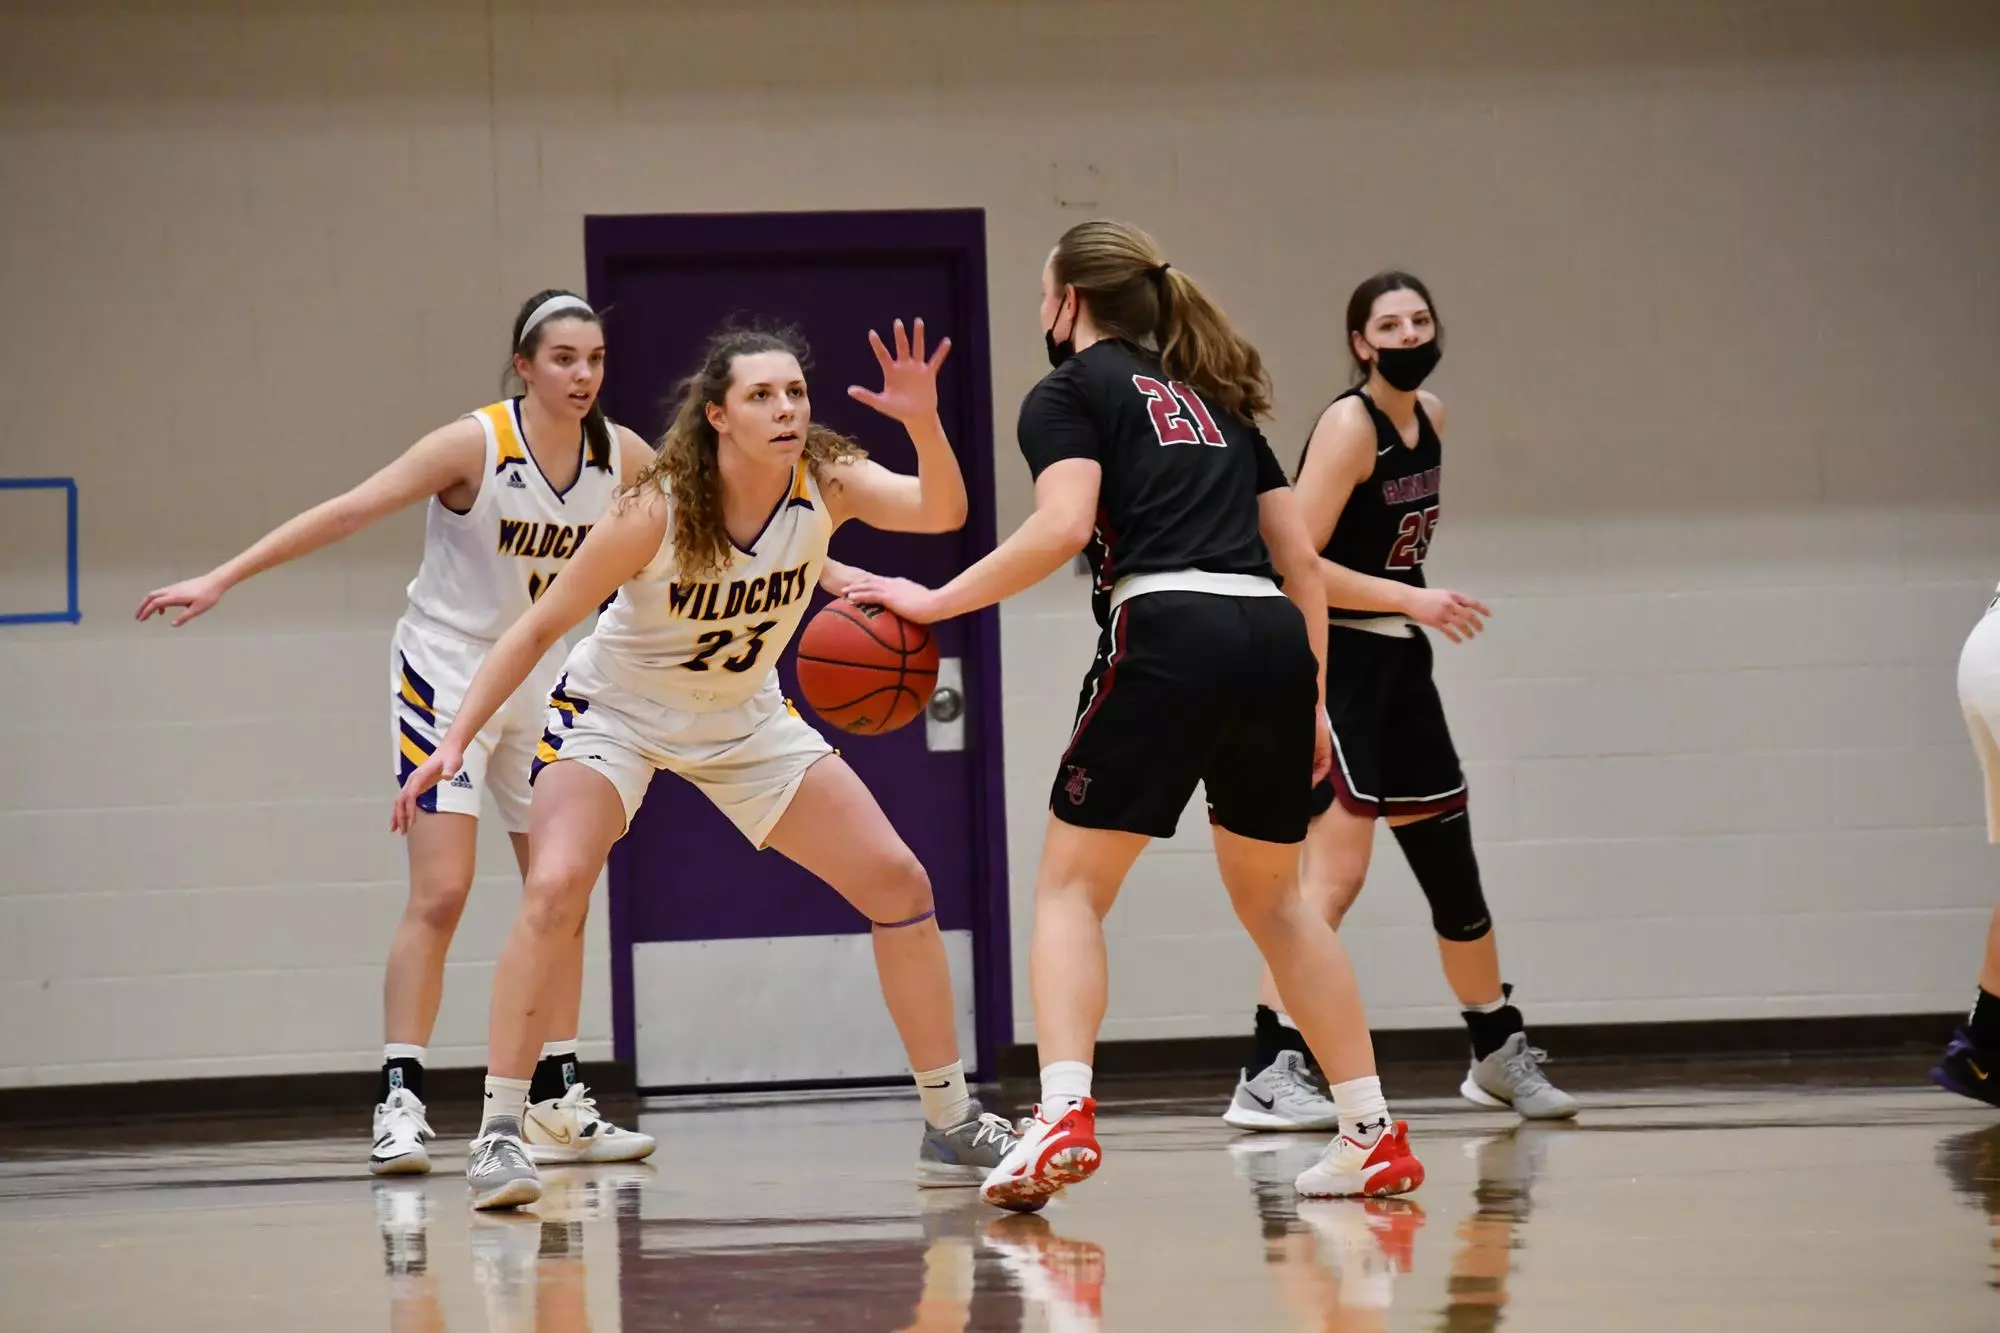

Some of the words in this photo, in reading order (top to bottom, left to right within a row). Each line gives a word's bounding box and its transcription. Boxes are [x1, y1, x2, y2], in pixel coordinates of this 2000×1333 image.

[1132, 374, 1228, 447] 21
[1385, 505, 1440, 570] 25
[669, 560, 810, 622] WILDCATS
[678, 620, 779, 673] 23
